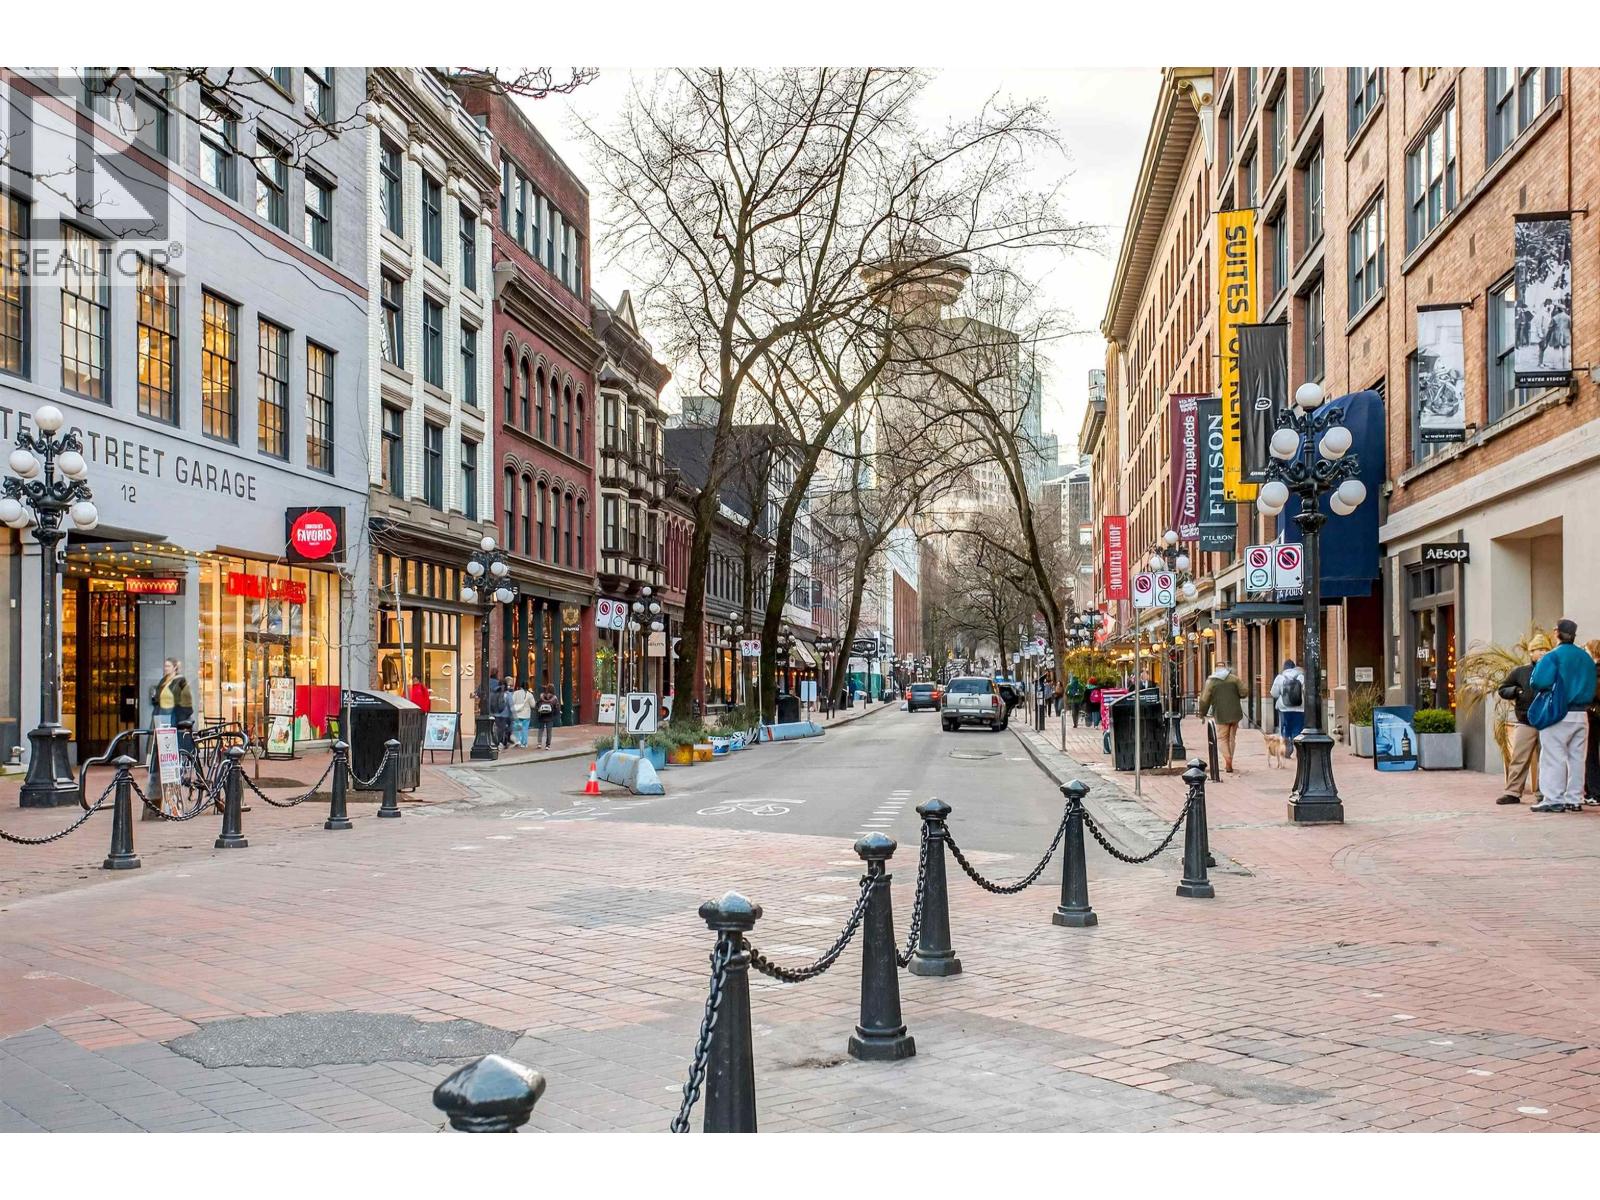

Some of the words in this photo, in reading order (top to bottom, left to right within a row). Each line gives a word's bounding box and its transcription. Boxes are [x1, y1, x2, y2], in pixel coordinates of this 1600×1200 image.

[1226, 225, 1249, 314] SUITES
[70, 426, 165, 478] STREET
[175, 455, 257, 501] GARAGE
[1183, 415, 1198, 471] spaghetti
[1208, 413, 1226, 517] FILSON
[121, 484, 136, 503] 12
[1184, 471, 1198, 518] factory
